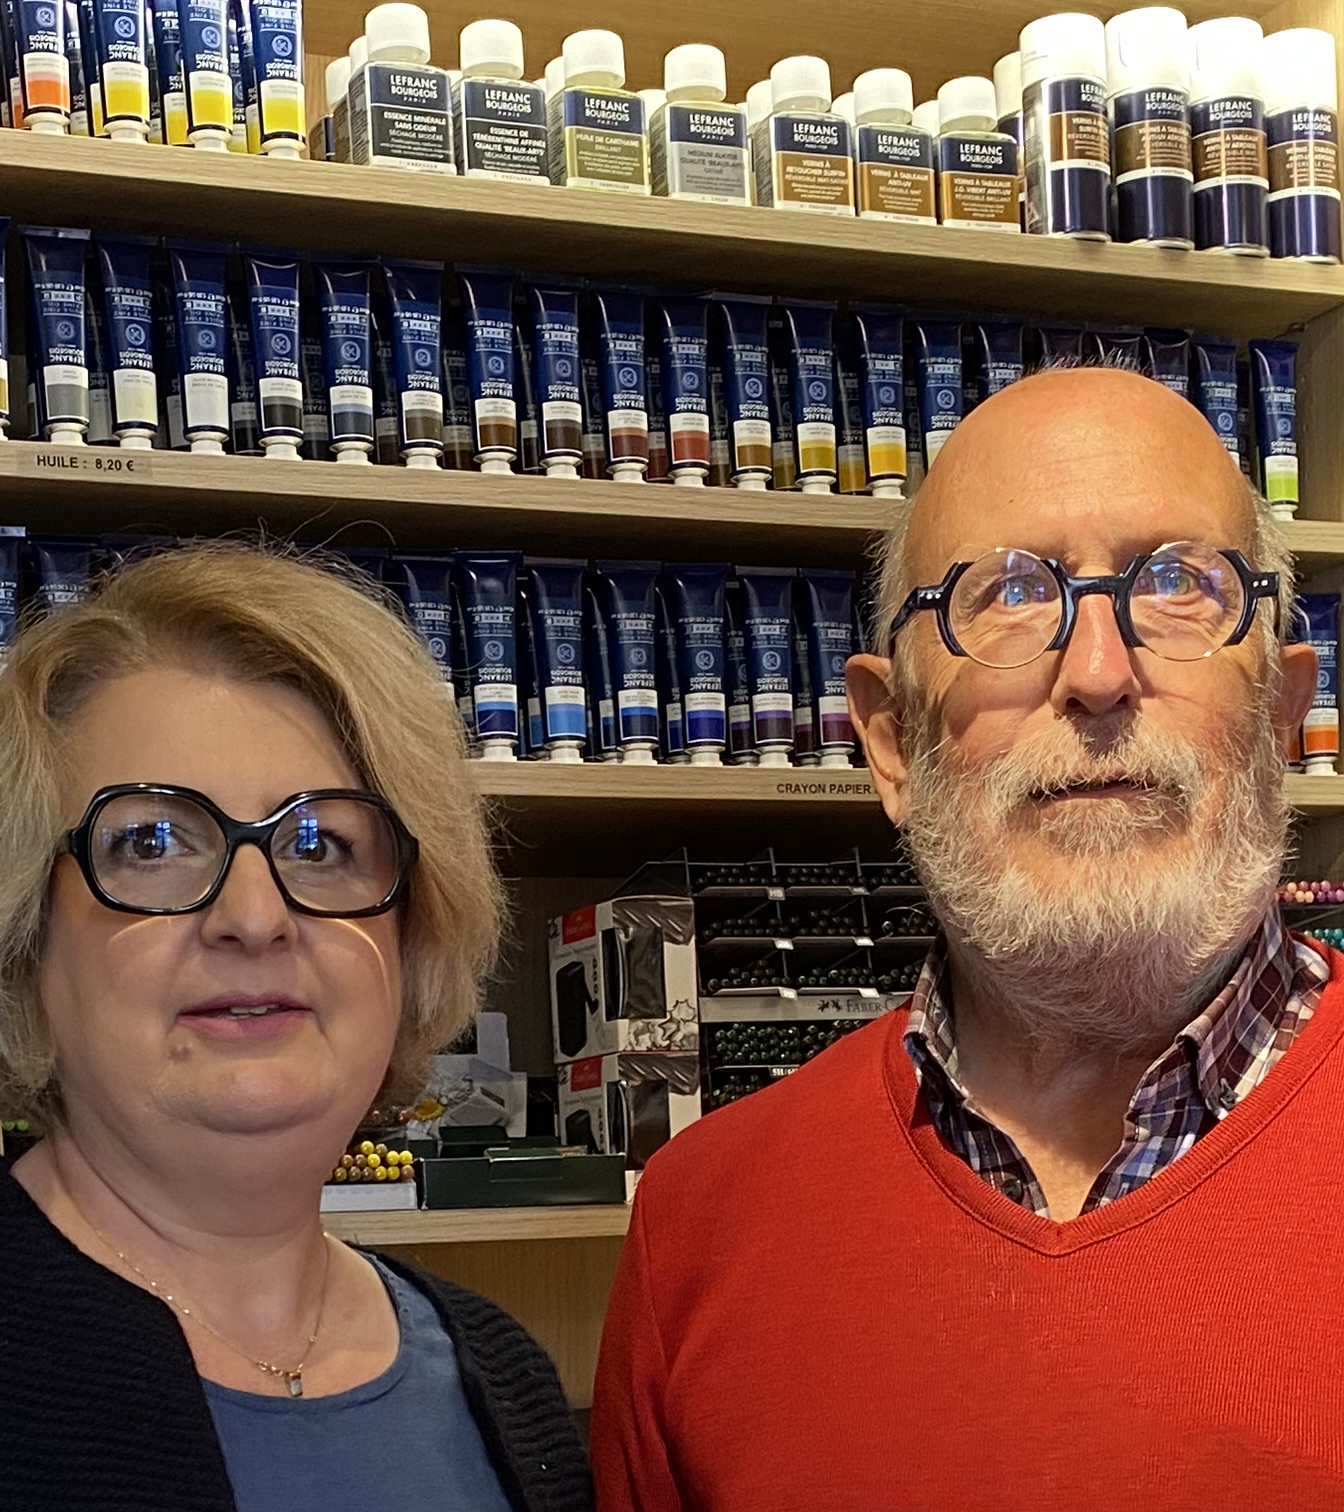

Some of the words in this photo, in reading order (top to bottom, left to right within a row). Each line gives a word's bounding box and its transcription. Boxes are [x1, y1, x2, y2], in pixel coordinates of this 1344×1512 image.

[390, 75, 438, 90] LEFRANC
[390, 86, 438, 99] BOURGEOIS
[484, 89, 531, 104] LEFRANC
[485, 100, 532, 114] BOURGEOIS
[584, 97, 629, 112] LEFRANC
[585, 108, 630, 122] BOURGEOIS
[689, 113, 734, 128] LEFRANC
[690, 123, 735, 137] BOURGEOIS
[793, 122, 838, 137] LEFRANC
[794, 133, 838, 146] BOURGEOIS
[877, 134, 920, 149] LEFRANC
[878, 144, 921, 158] BOURGEOIS
[960, 143, 1003, 157] LEFRANC
[960, 152, 1003, 165] BOURGEOIS
[36, 455, 77, 470] HUILE
[94, 458, 124, 474] 8,20
[125, 459, 135, 473] €
[775, 781, 824, 796] CRAYON
[827, 782, 872, 797] PAPIER
